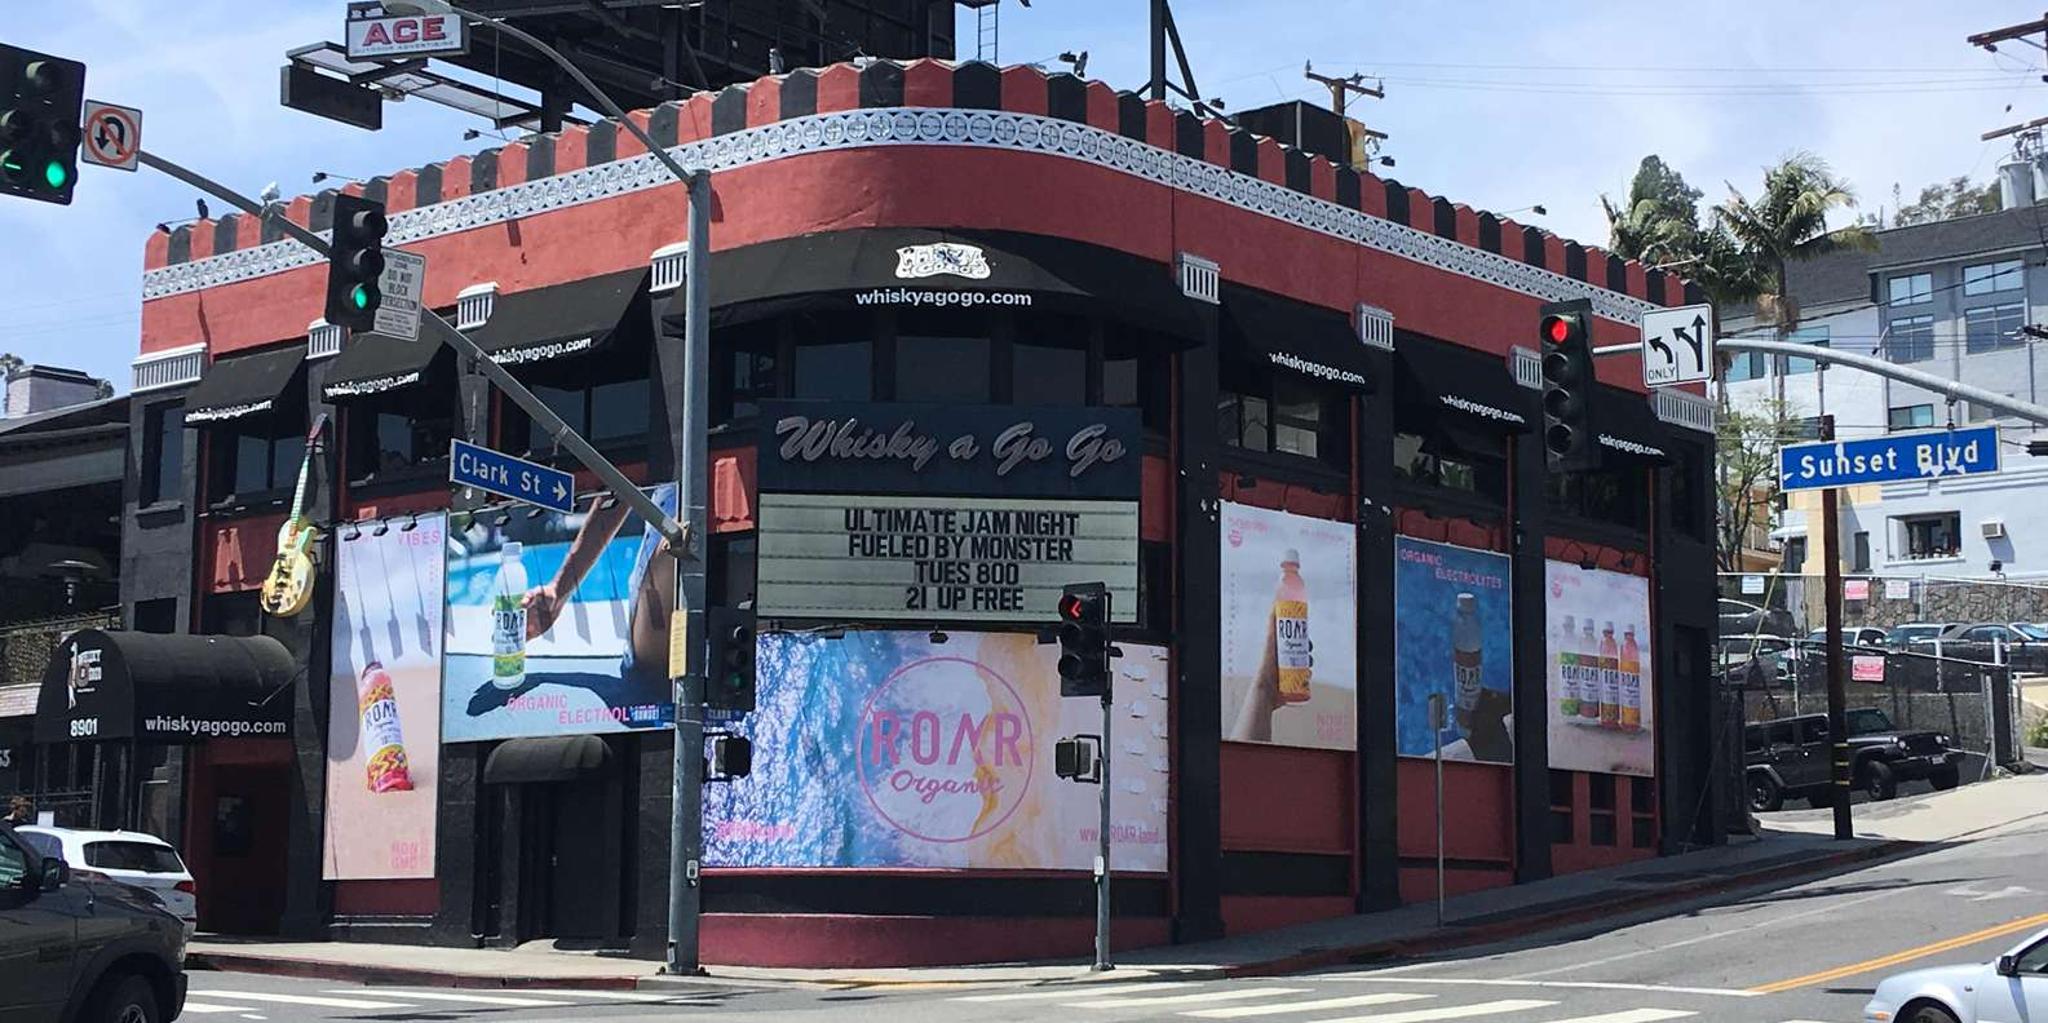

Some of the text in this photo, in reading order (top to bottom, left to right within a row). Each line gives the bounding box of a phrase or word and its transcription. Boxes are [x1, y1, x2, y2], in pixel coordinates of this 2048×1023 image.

[363, 17, 446, 47] ACE
[388, 268, 413, 284] DO NOT
[388, 282, 408, 296] BLOCK
[856, 288, 1032, 307] whiskyagogo.com
[1269, 352, 1365, 385] whiskyagogo.com
[1648, 367, 1676, 380] ONLY
[1440, 394, 1526, 424] whiskyagogo.com
[775, 415, 1127, 478] Whisky a Go Go
[1800, 440, 1979, 479] Sunset Blvd
[460, 453, 542, 496] Clark St
[844, 508, 1080, 537] ULTIMATE JAM NIGHT
[398, 530, 440, 546] VIBES
[848, 534, 1073, 562] FUELED BY MONSTER
[914, 561, 969, 584] TUES
[905, 587, 1024, 611] 21 UP FREE
[507, 694, 568, 711] ORGANIC
[145, 715, 286, 737] whiskyagogo.com
[559, 705, 632, 725] ELECTROL
[70, 718, 98, 737] 8901
[870, 709, 1023, 767] ROAR
[890, 769, 1004, 803] Organic
